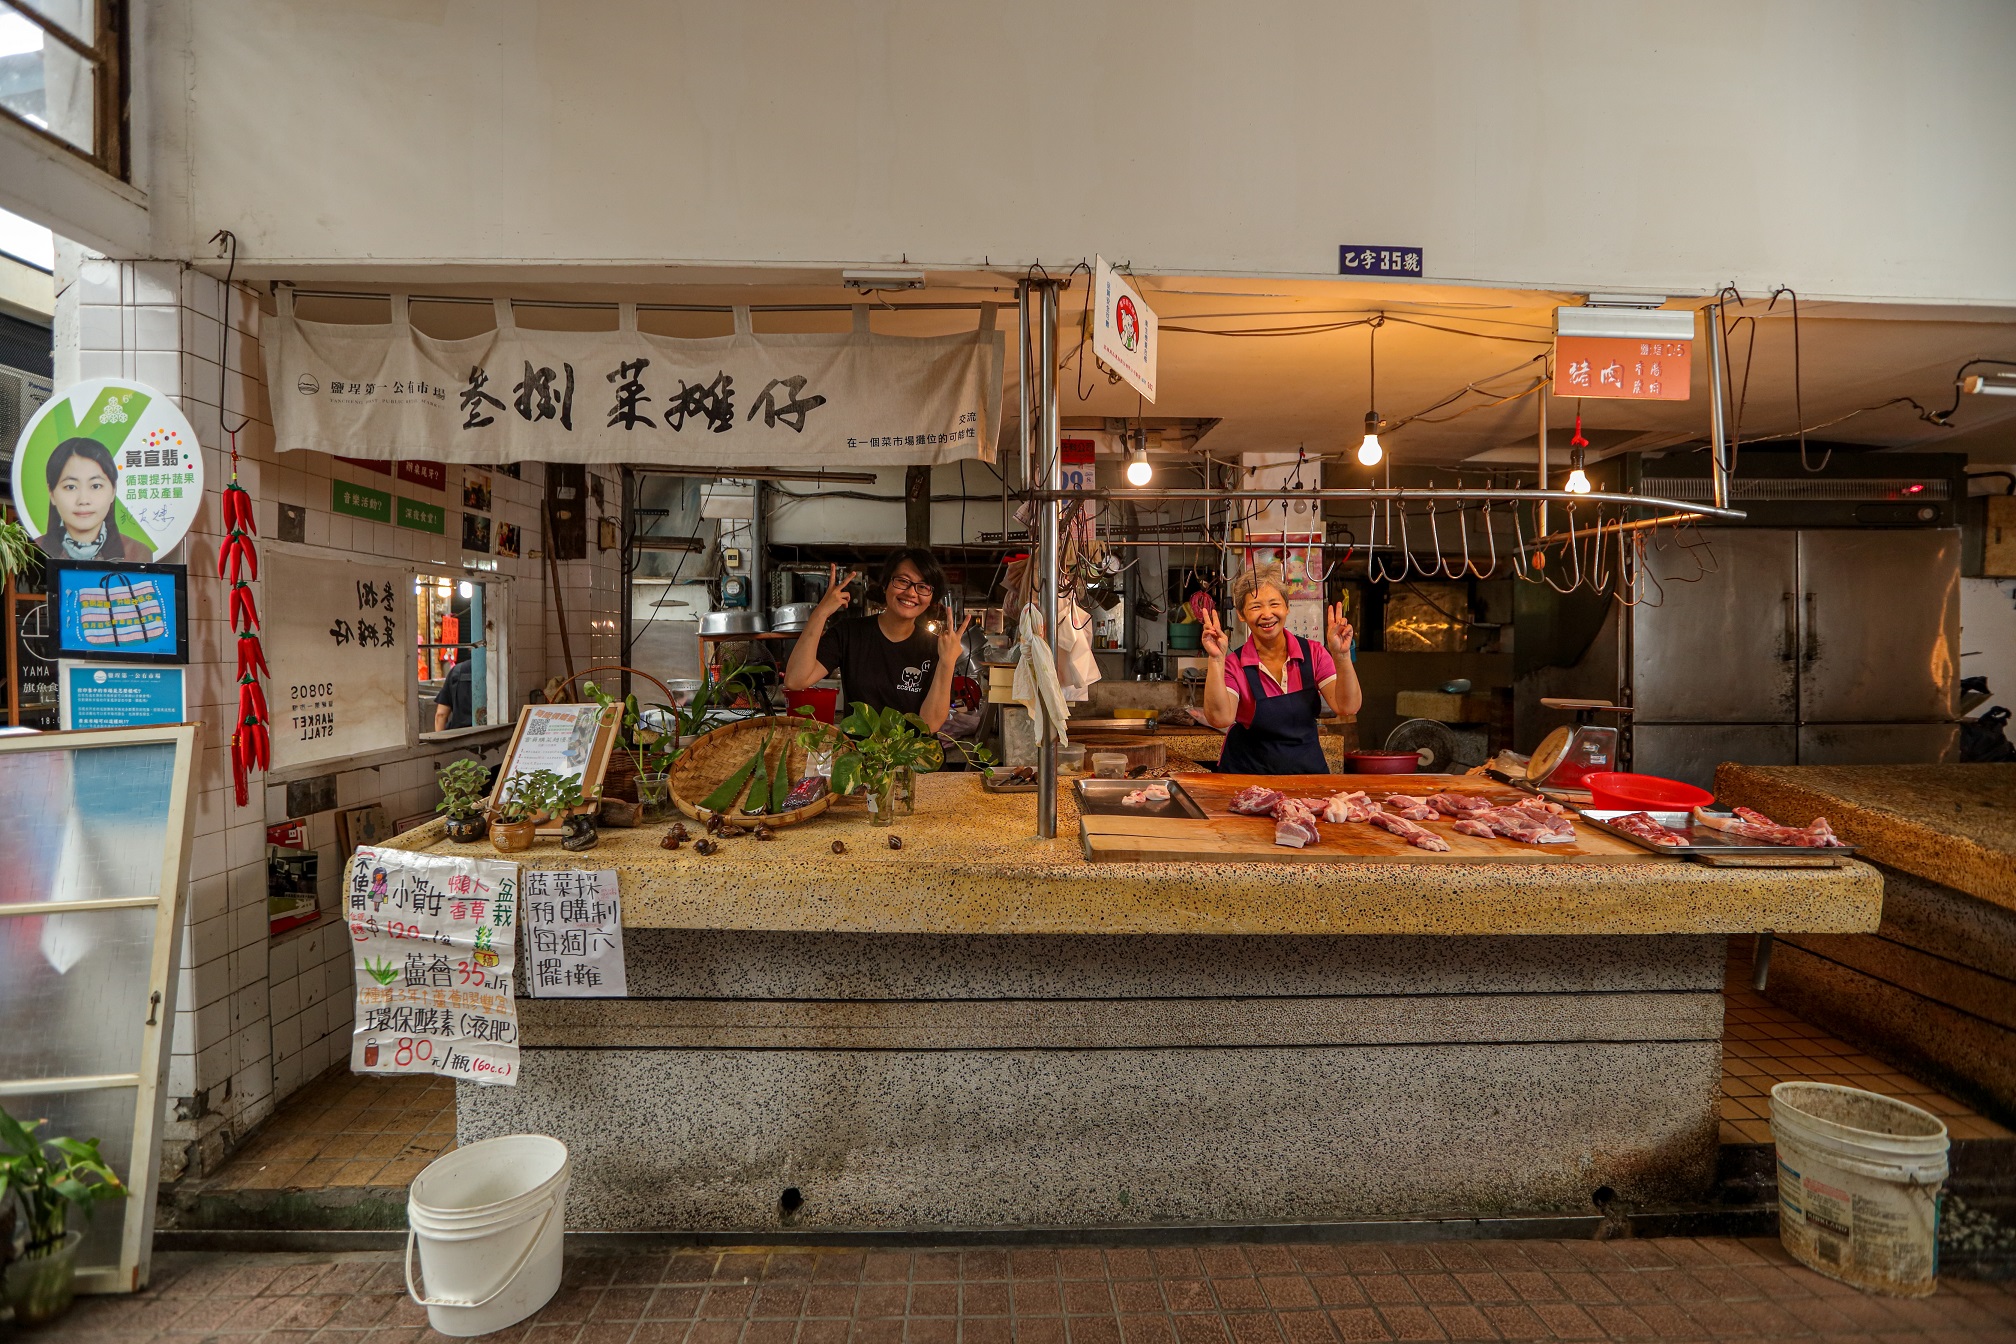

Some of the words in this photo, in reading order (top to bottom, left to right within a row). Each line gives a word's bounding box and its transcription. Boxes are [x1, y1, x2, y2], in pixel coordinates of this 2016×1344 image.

[1345, 249, 1420, 272] 乙字35號
[958, 411, 977, 425] 交流
[846, 427, 976, 448] 在一個菜市場攤位的可能性
[125, 449, 179, 468] 黃宣翡
[125, 472, 195, 487] 循環提升蔬果
[125, 487, 184, 500] 品質及產量
[342, 491, 383, 511] 音樂活動?
[22, 665, 50, 677] YAMA
[896, 684, 922, 693] ECSTASY
[448, 875, 490, 894] 懶人
[527, 873, 601, 900] 蔬菜採
[392, 875, 446, 916] 小資女
[492, 877, 517, 927] 盆栽
[449, 901, 486, 924] 香草
[531, 900, 617, 925] 預購制
[533, 929, 615, 956] 每週六
[536, 958, 603, 988] 擺攤
[1807, 1213, 1848, 1232] KIRKLAND
